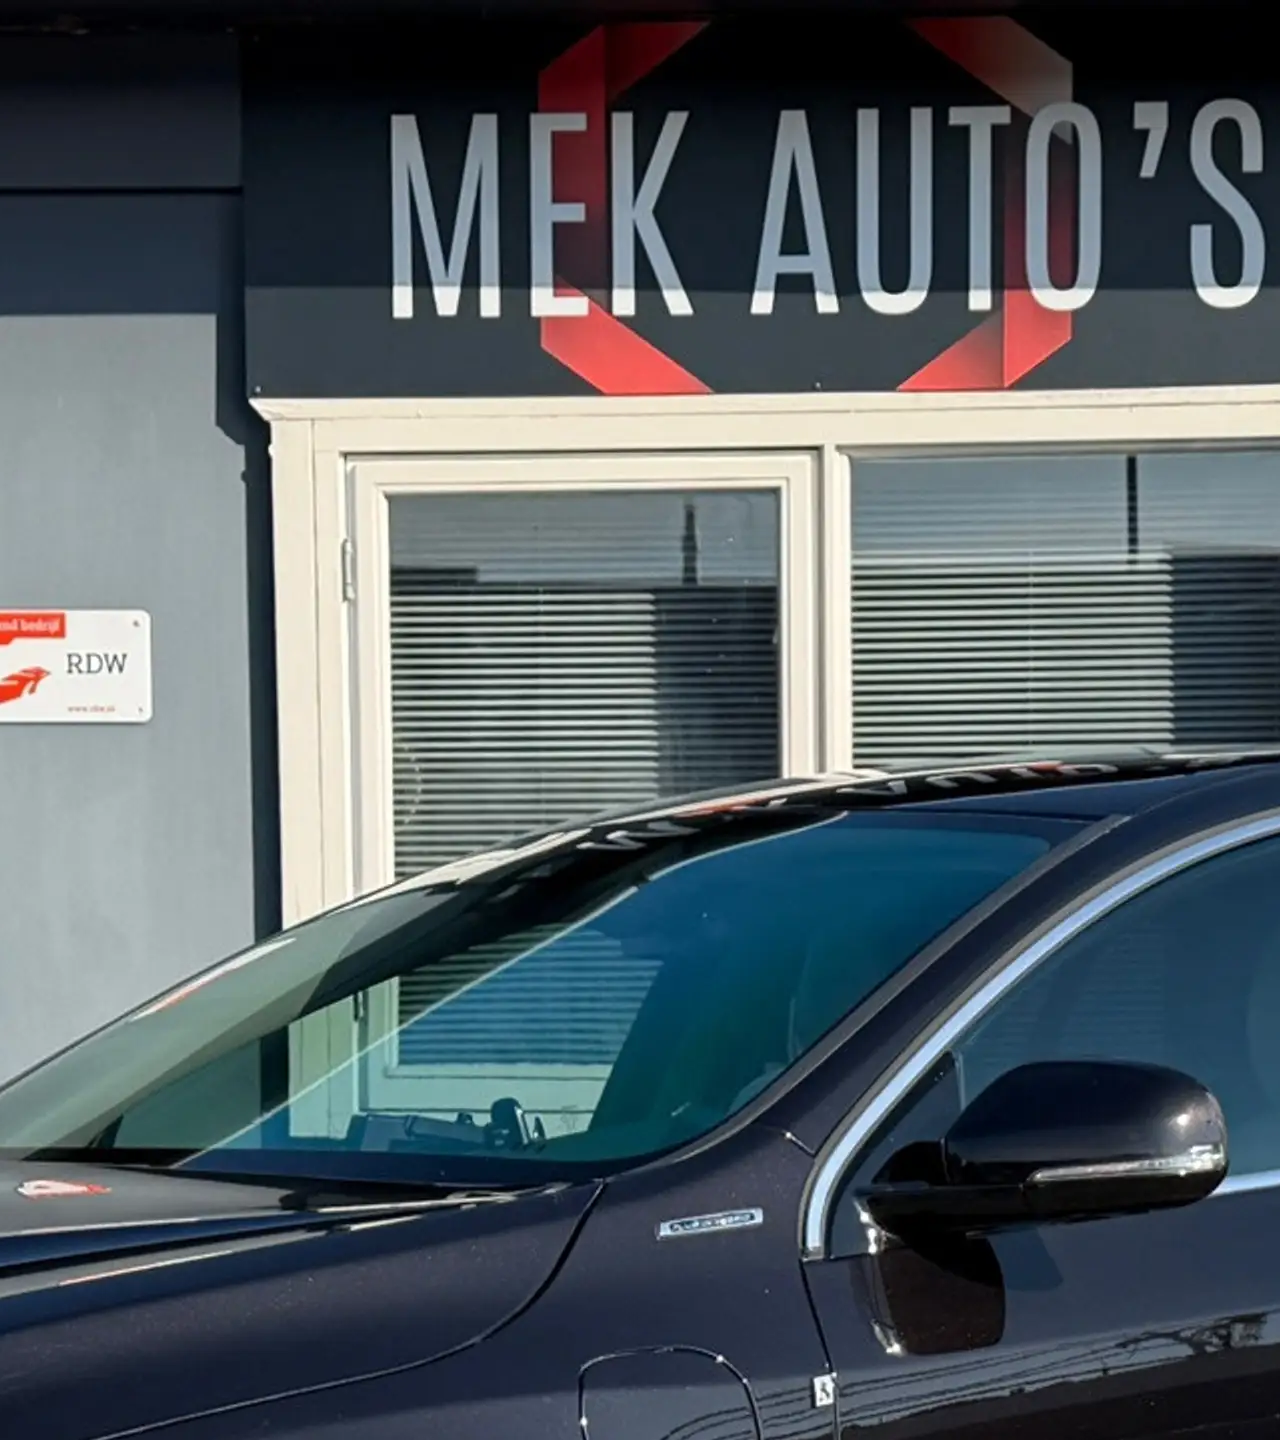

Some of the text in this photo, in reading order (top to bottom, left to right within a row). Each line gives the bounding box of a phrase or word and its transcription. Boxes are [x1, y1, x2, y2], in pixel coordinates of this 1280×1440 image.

[390, 98, 1266, 319] MEK AUTO'S
[66, 652, 128, 675] RDW
